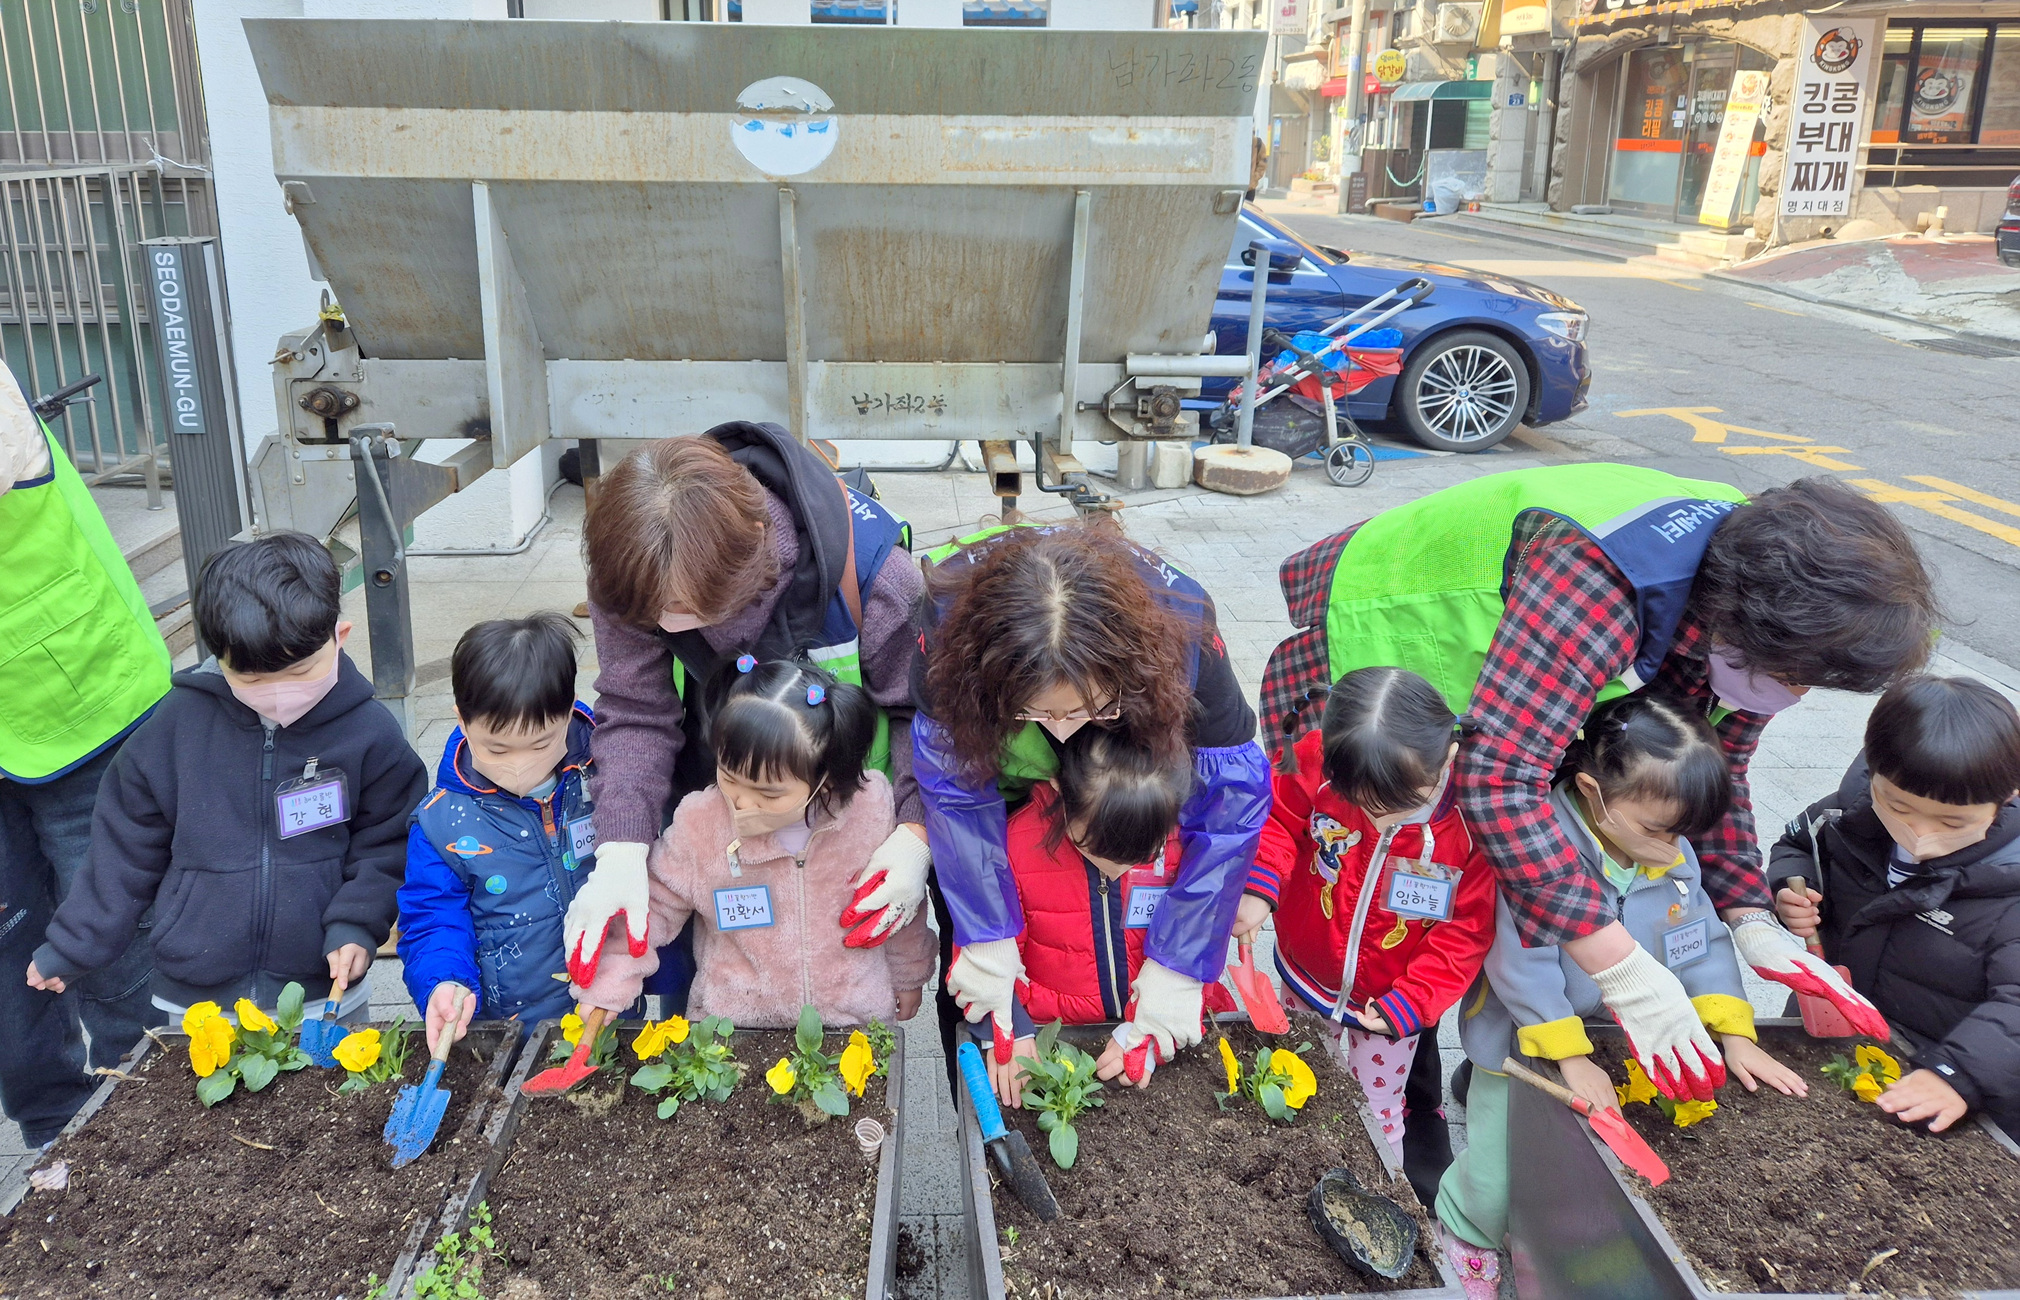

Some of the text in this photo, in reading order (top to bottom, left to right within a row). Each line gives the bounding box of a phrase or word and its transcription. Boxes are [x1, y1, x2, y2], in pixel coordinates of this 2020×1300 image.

[1108, 48, 1257, 93] 남가좌2동
[1377, 63, 1403, 79] 닭갈비
[1819, 60, 1850, 73] KINGKONG
[1644, 99, 1664, 117] 킹콩
[1802, 82, 1860, 114] 킹콩
[1796, 121, 1854, 153] 부대
[1790, 161, 1849, 192] 찌개
[1787, 200, 1844, 213] 명지대점
[155, 252, 199, 427] SEODAEMUN-GU
[851, 392, 948, 416] 남가좌2동
[722, 903, 765, 922] 김환서
[1396, 890, 1439, 912] 임하늘
